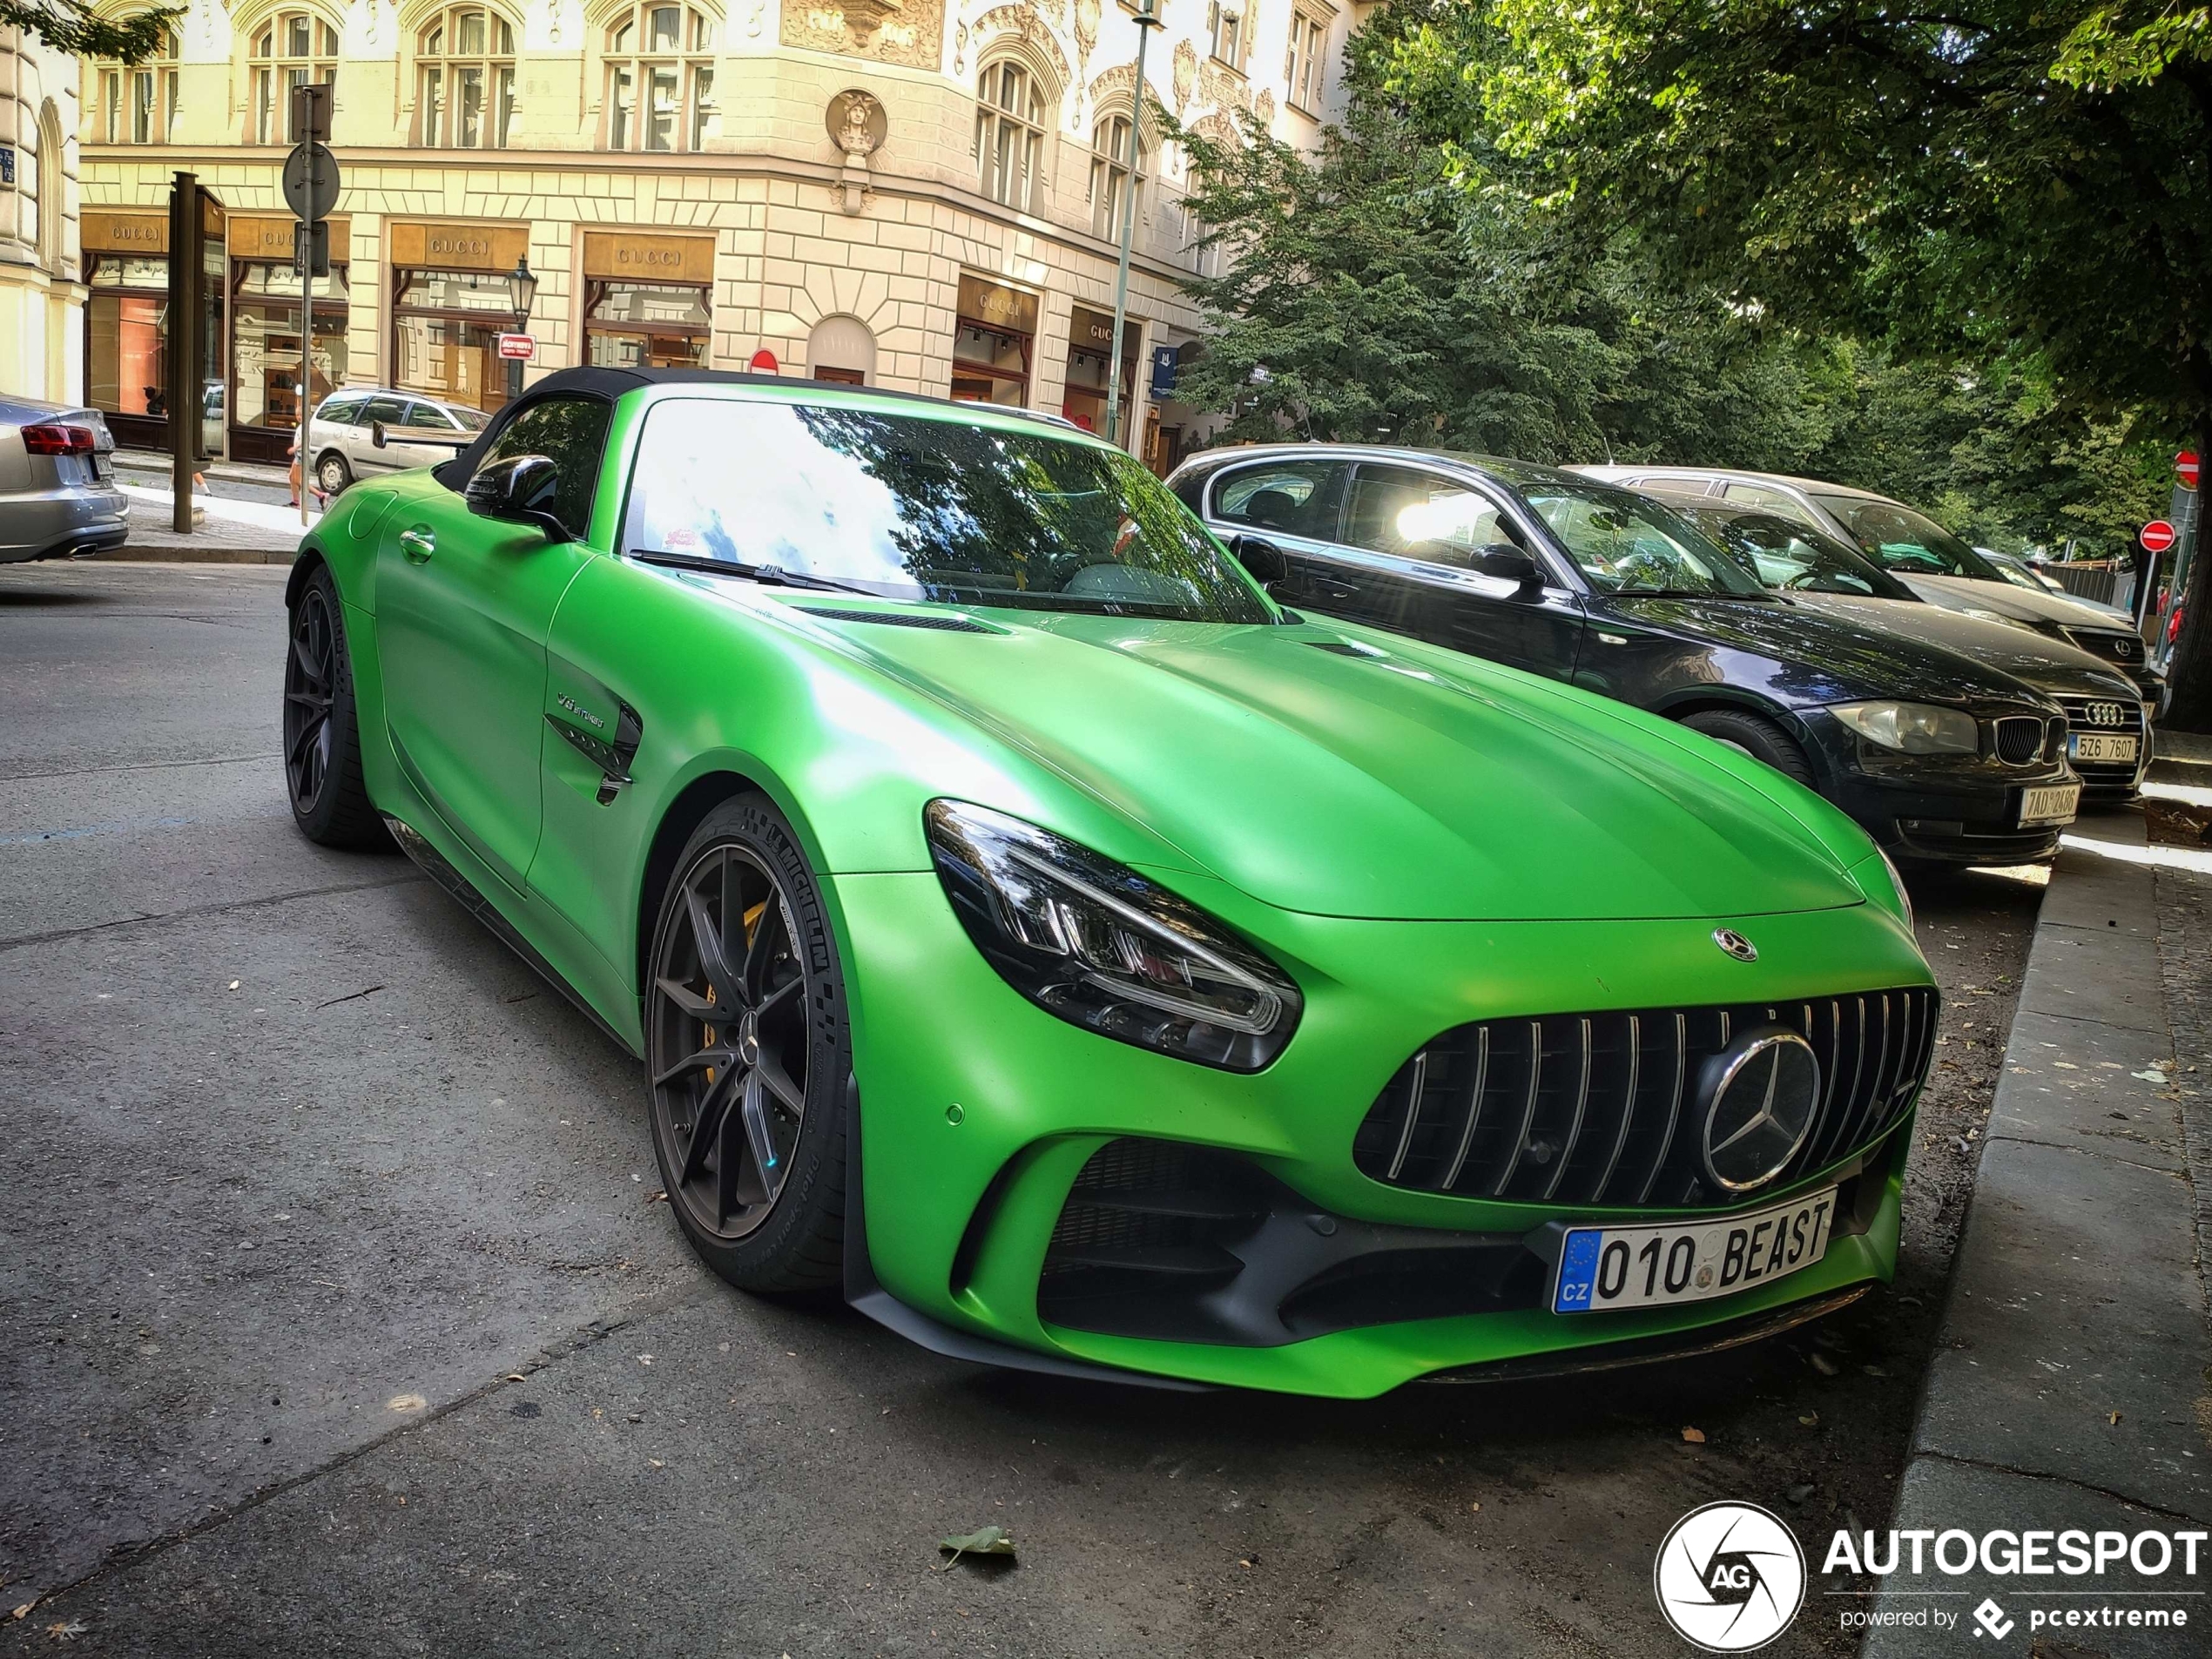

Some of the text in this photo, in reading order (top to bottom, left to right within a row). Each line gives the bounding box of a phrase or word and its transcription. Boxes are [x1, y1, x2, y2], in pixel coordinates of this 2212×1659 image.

[113, 226, 159, 240] GUCCI
[265, 232, 294, 246] GUC
[430, 239, 489, 254] GUCCI
[617, 248, 681, 266] GUCCI
[979, 293, 1021, 318] GUCCI
[1090, 324, 1113, 341] GUC
[557, 691, 604, 728] V8 BITURBO
[2080, 738, 2132, 759] 5Z6 7607
[2027, 788, 2075, 816] 7AD 2486
[779, 846, 828, 968] MICHELIN
[799, 1153, 821, 1203] Pilot
[777, 1202, 803, 1246] Sport
[1597, 1200, 1830, 1299] 010 BEAST
[1562, 1283, 1588, 1302] CZ
